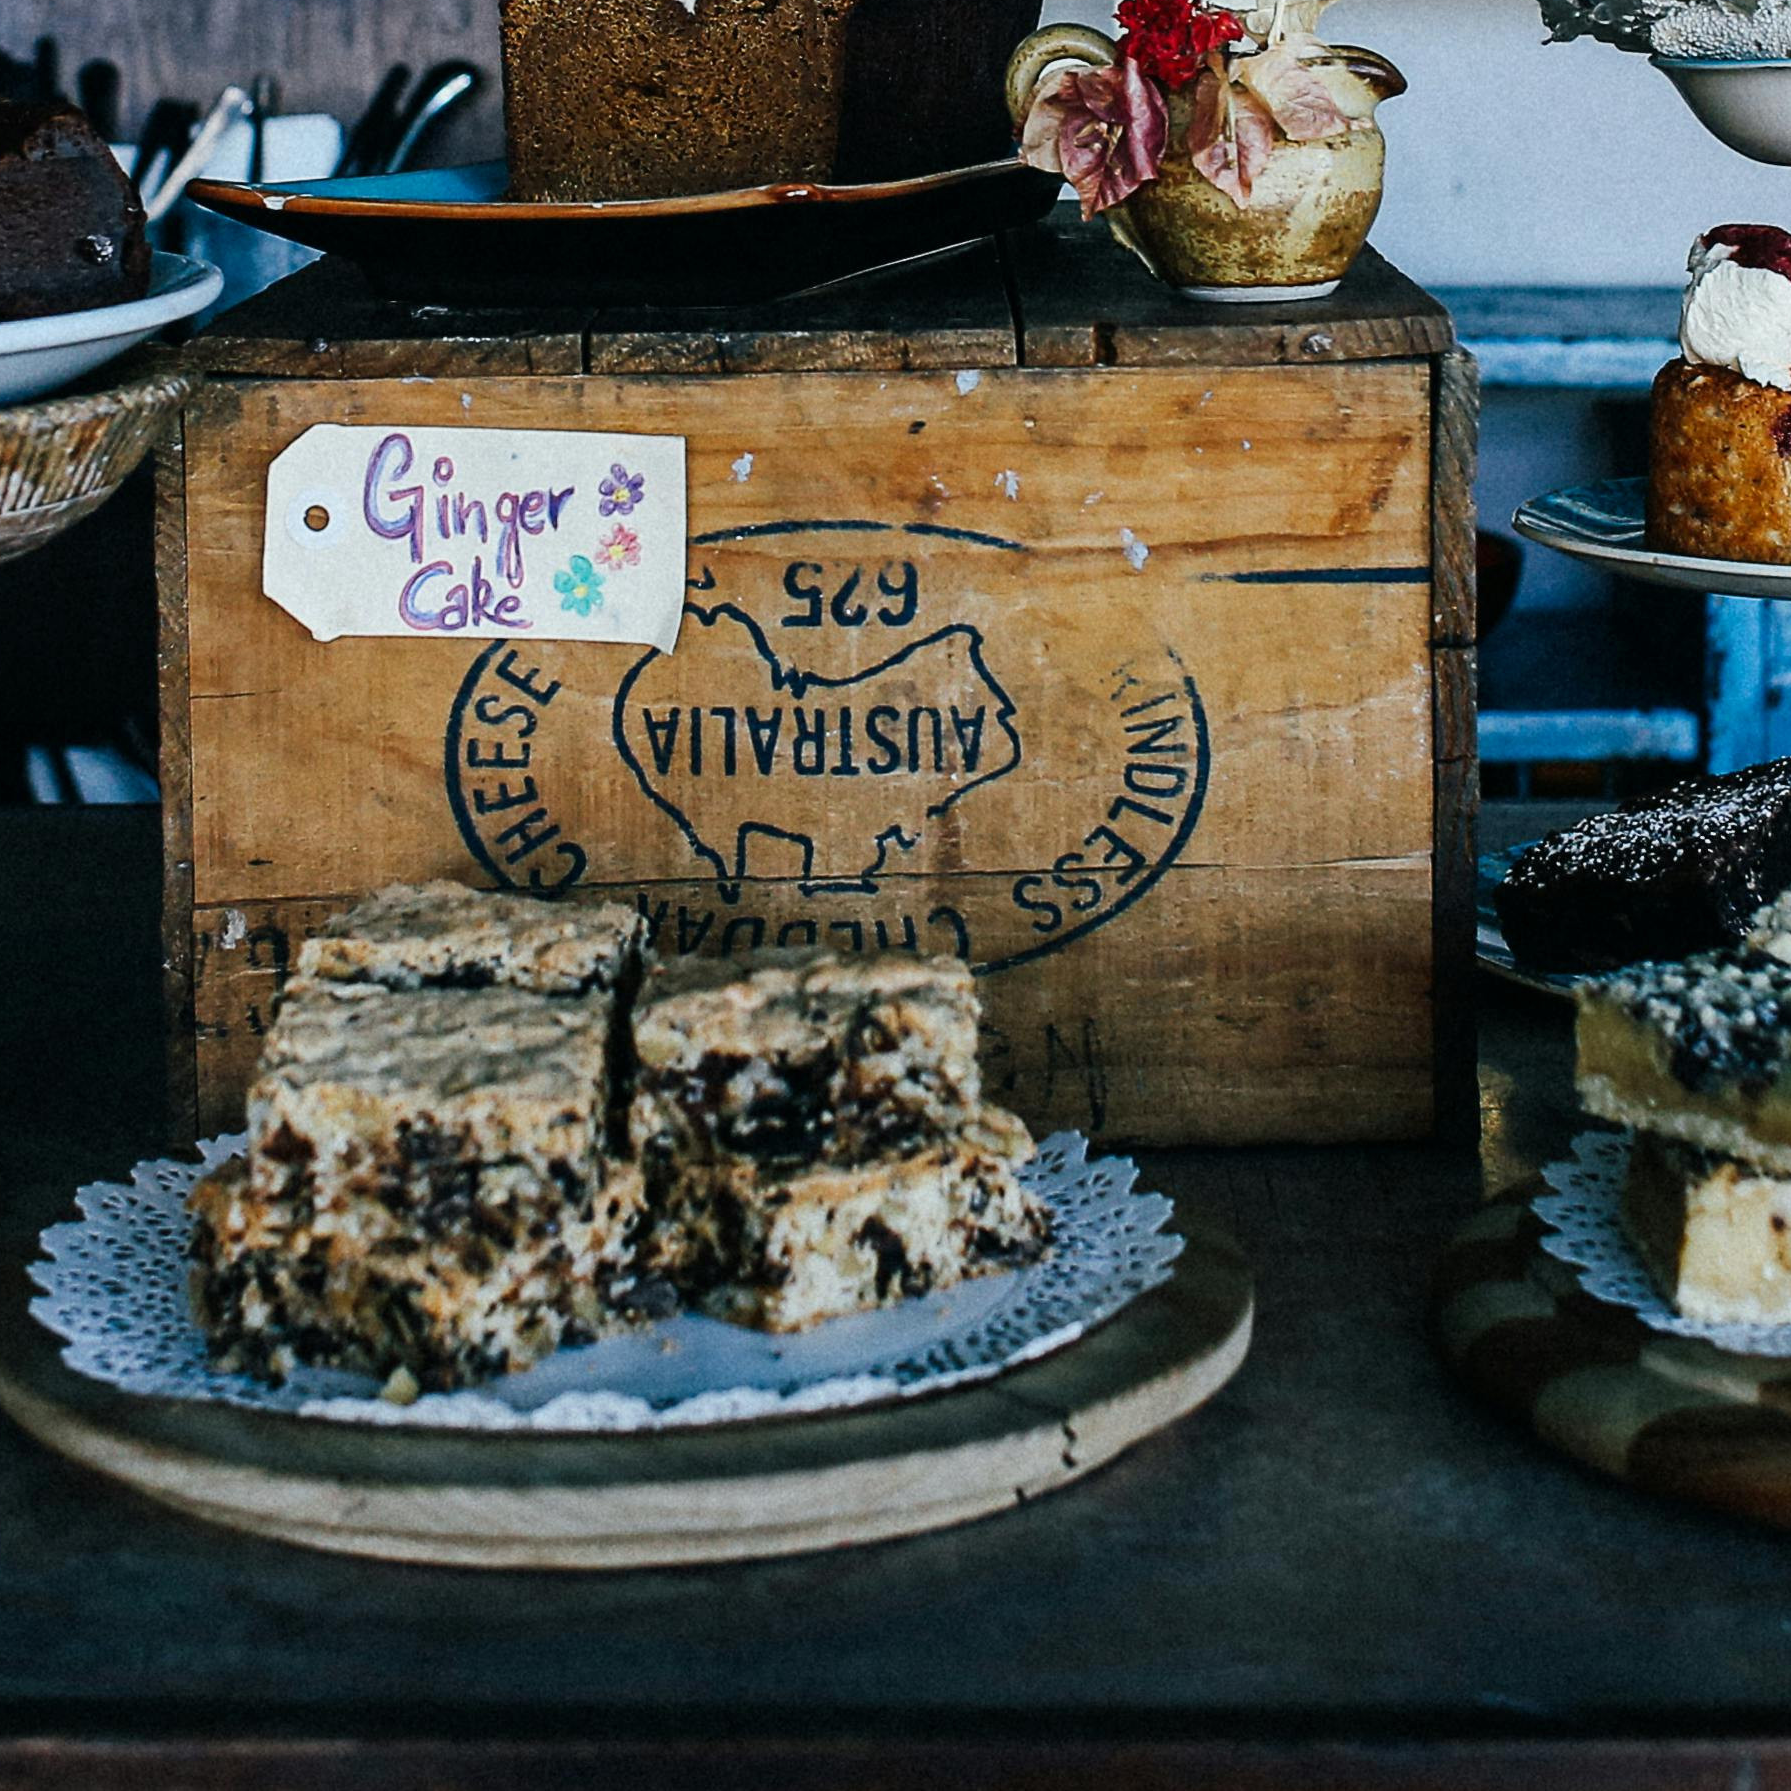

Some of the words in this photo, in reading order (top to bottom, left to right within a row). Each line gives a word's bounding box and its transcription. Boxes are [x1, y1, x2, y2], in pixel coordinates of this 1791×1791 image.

[363, 432, 575, 588] Ginger
[399, 555, 534, 630] Cake
[467, 649, 588, 902] CHEESE
[643, 705, 986, 776] AUSTRALIA
